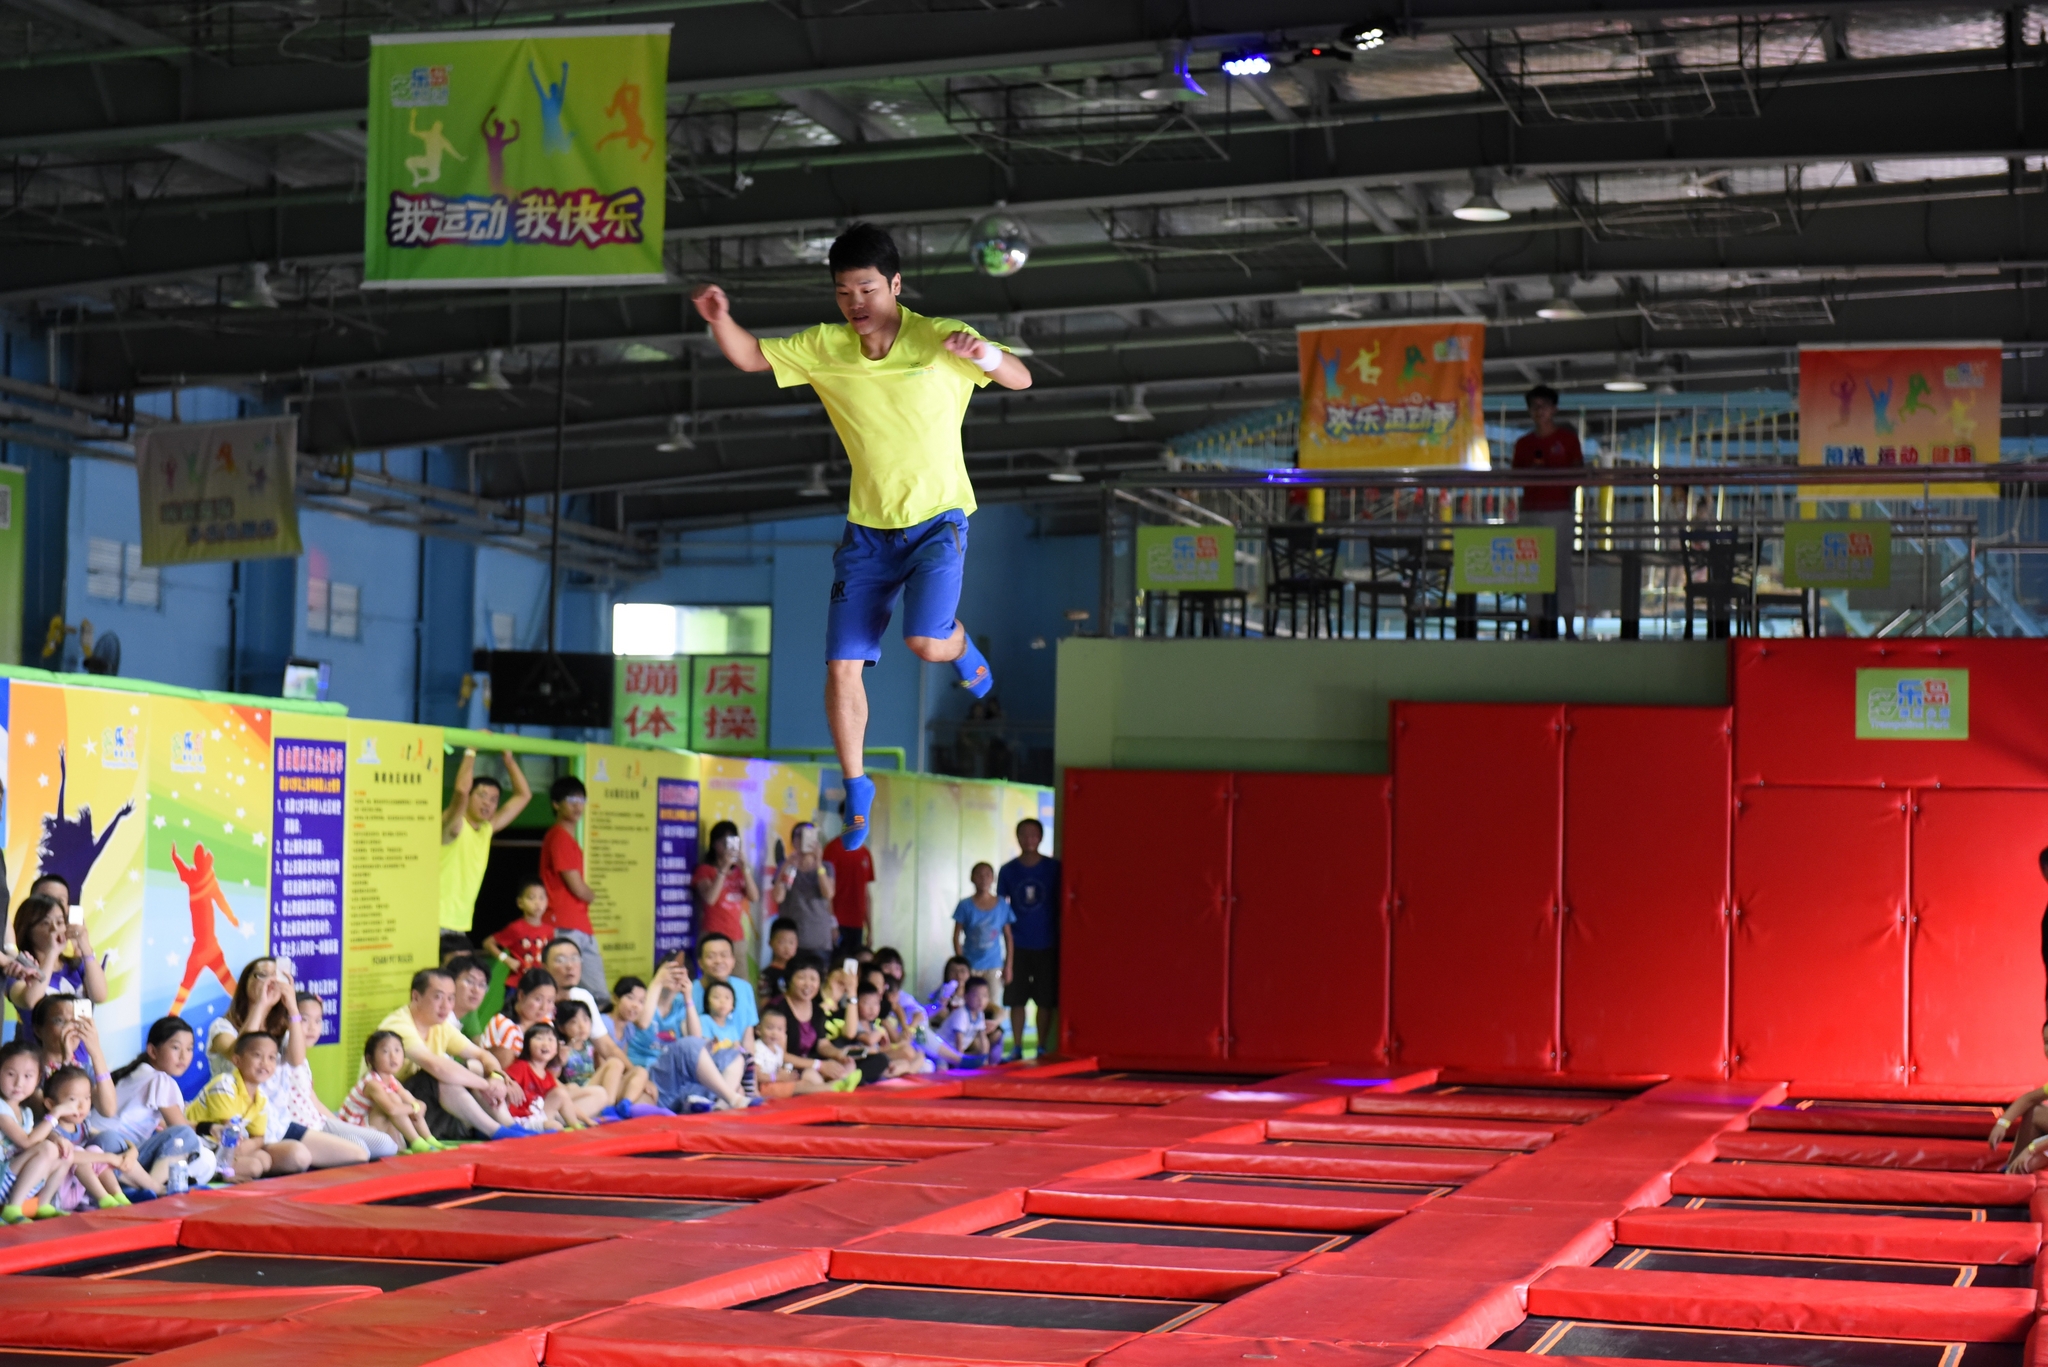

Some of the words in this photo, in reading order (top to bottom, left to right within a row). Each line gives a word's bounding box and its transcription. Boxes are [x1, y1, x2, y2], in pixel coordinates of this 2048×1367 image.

[390, 195, 509, 243] 我运动
[515, 193, 641, 243] 我快乐
[1878, 445, 1918, 465] 运动
[1932, 445, 1972, 464] 健康
[625, 661, 757, 697] 蹦床
[624, 704, 757, 739] 体操
